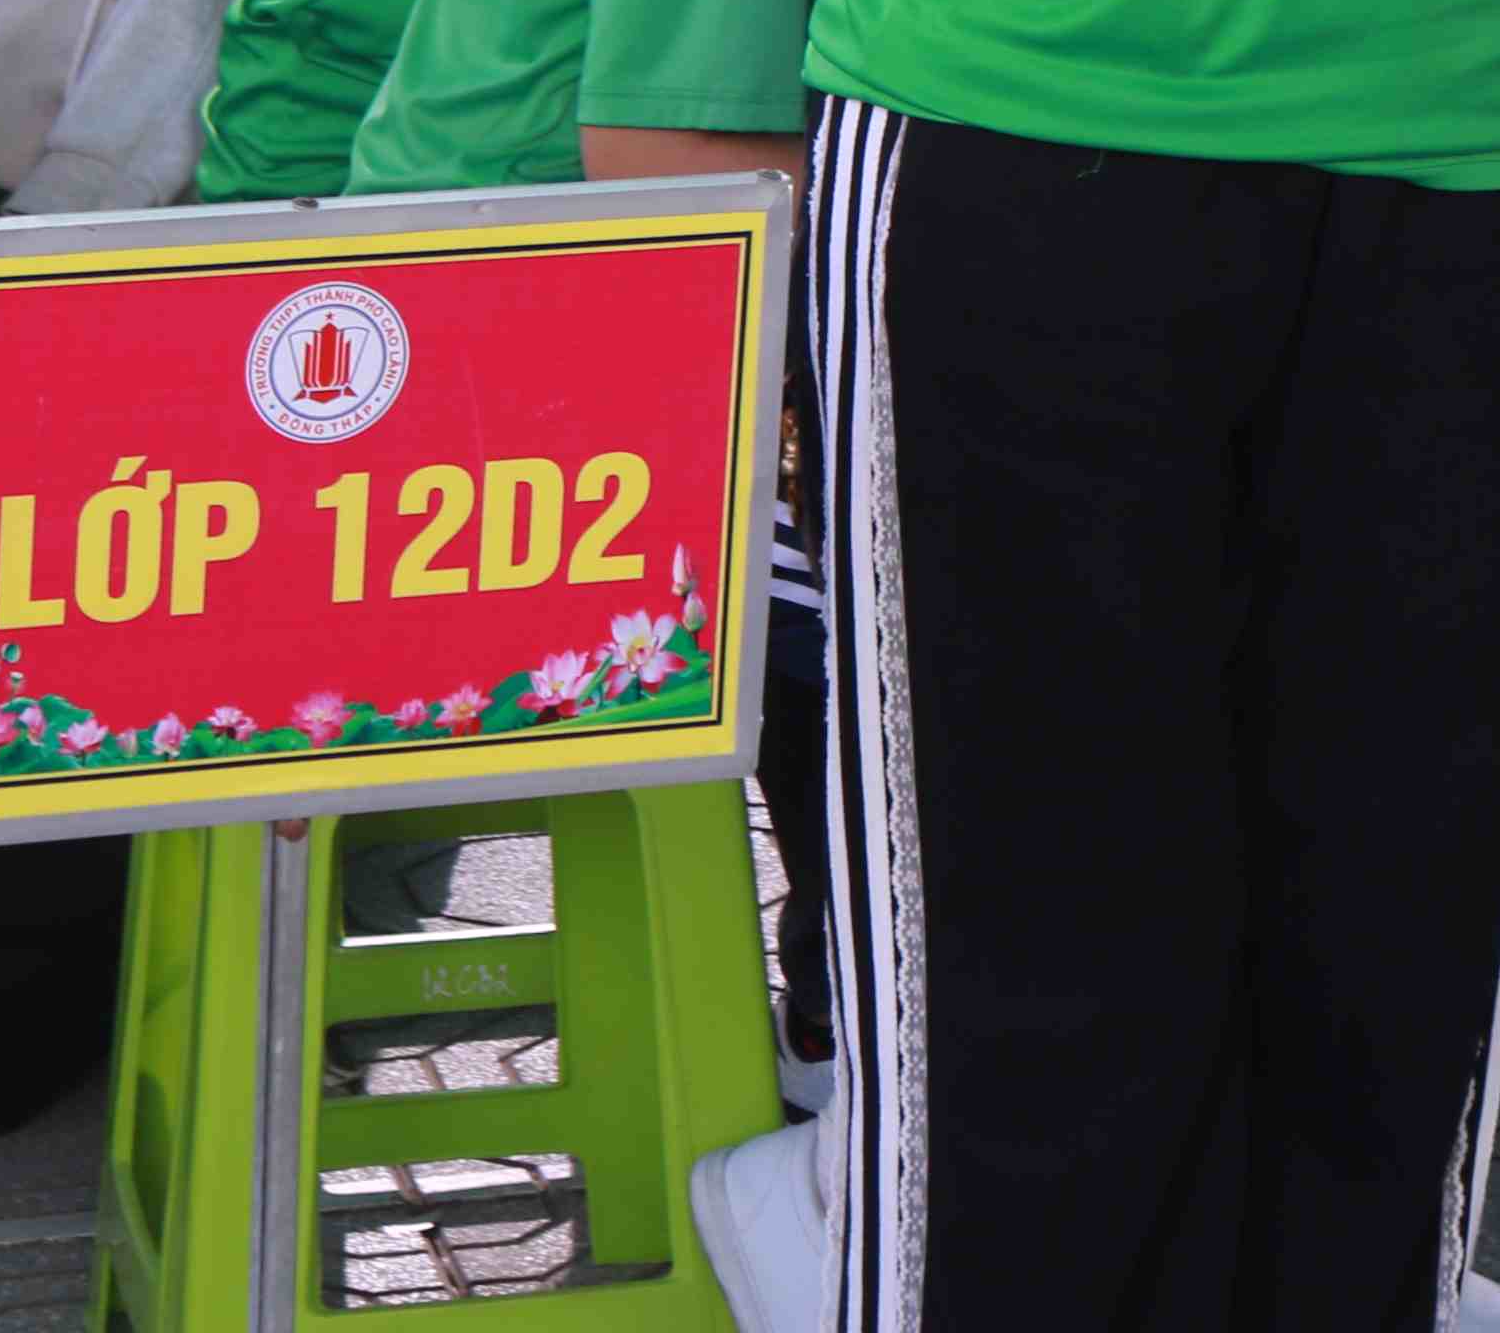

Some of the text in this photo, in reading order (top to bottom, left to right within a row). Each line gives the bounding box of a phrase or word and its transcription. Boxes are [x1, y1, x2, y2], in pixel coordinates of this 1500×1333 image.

[271, 303, 301, 331] THPT
[380, 317, 400, 347] CAO
[314, 451, 652, 603] 12D2
